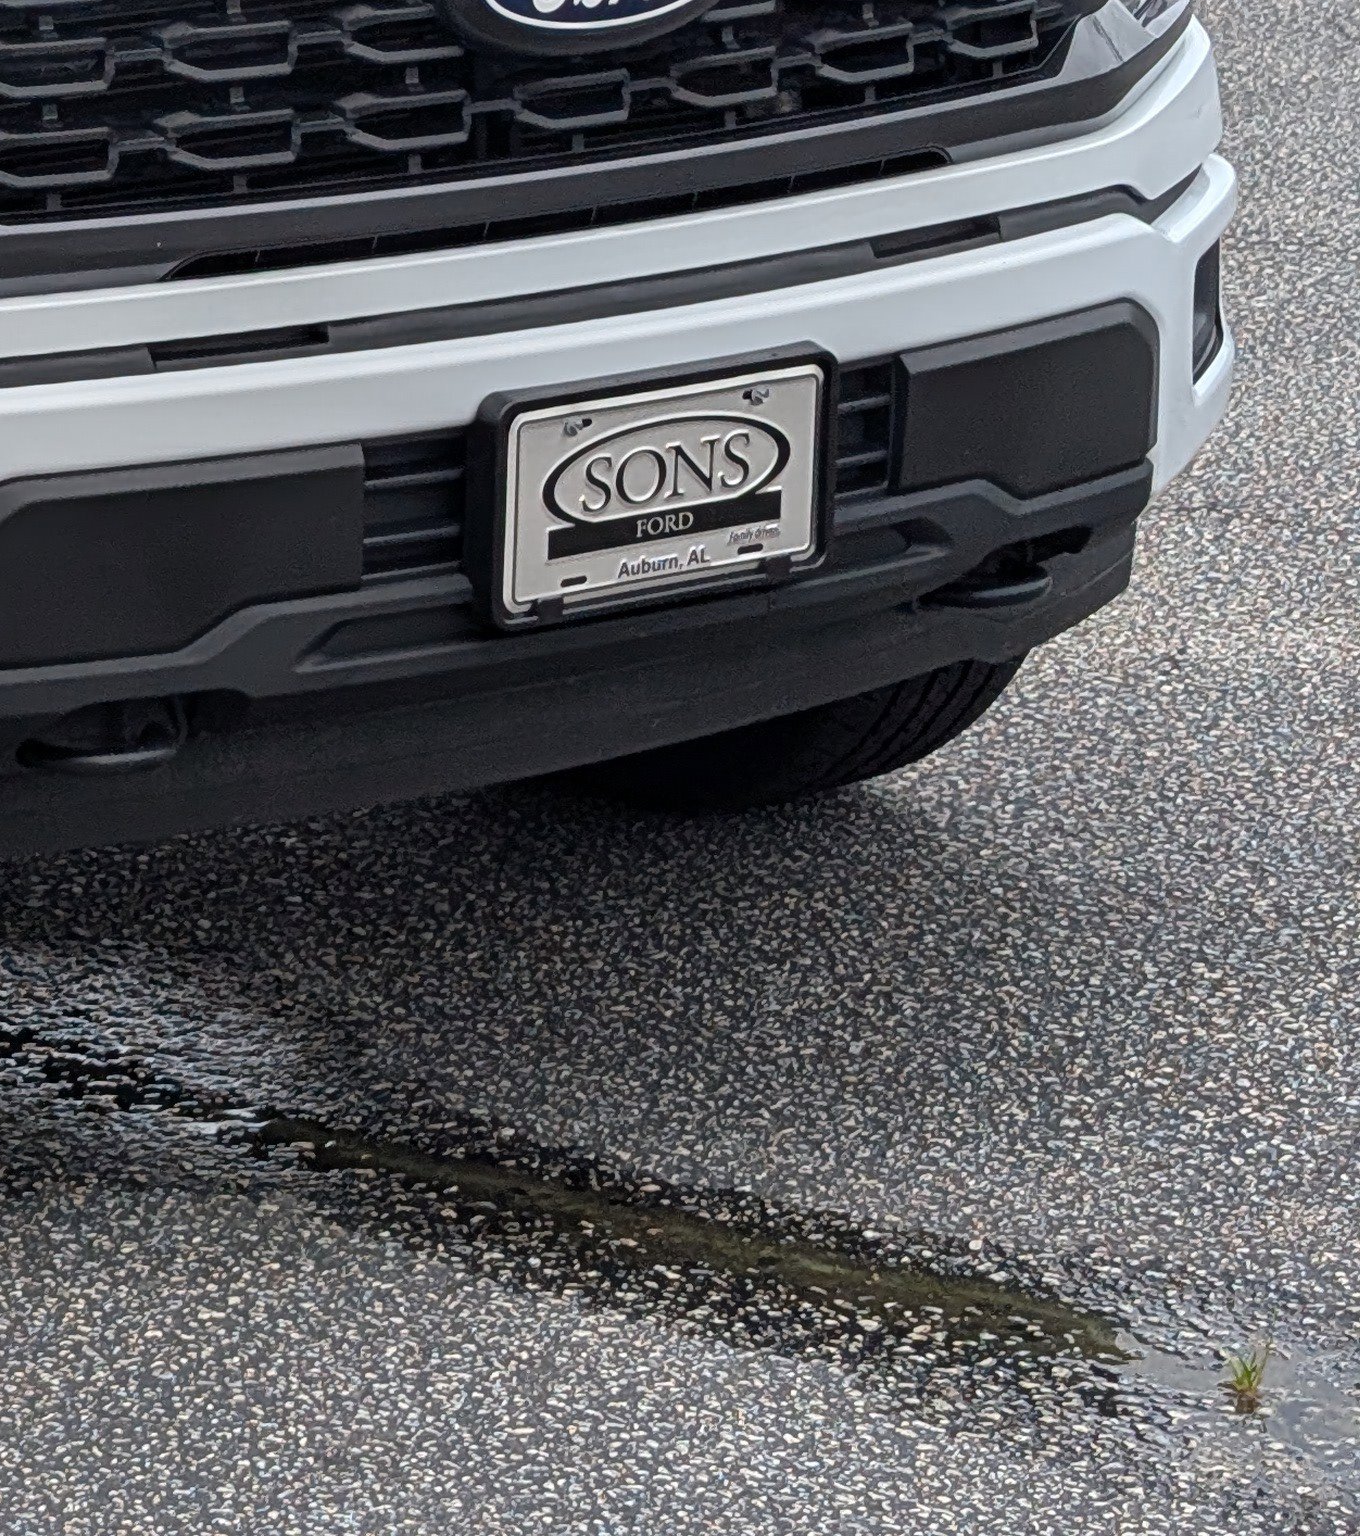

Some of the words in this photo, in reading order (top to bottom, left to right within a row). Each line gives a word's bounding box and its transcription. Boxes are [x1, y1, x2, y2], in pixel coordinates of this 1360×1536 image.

[579, 428, 752, 513] SONS
[636, 511, 694, 538] FORD
[617, 553, 683, 579] Auburn,
[687, 544, 711, 566] AL
